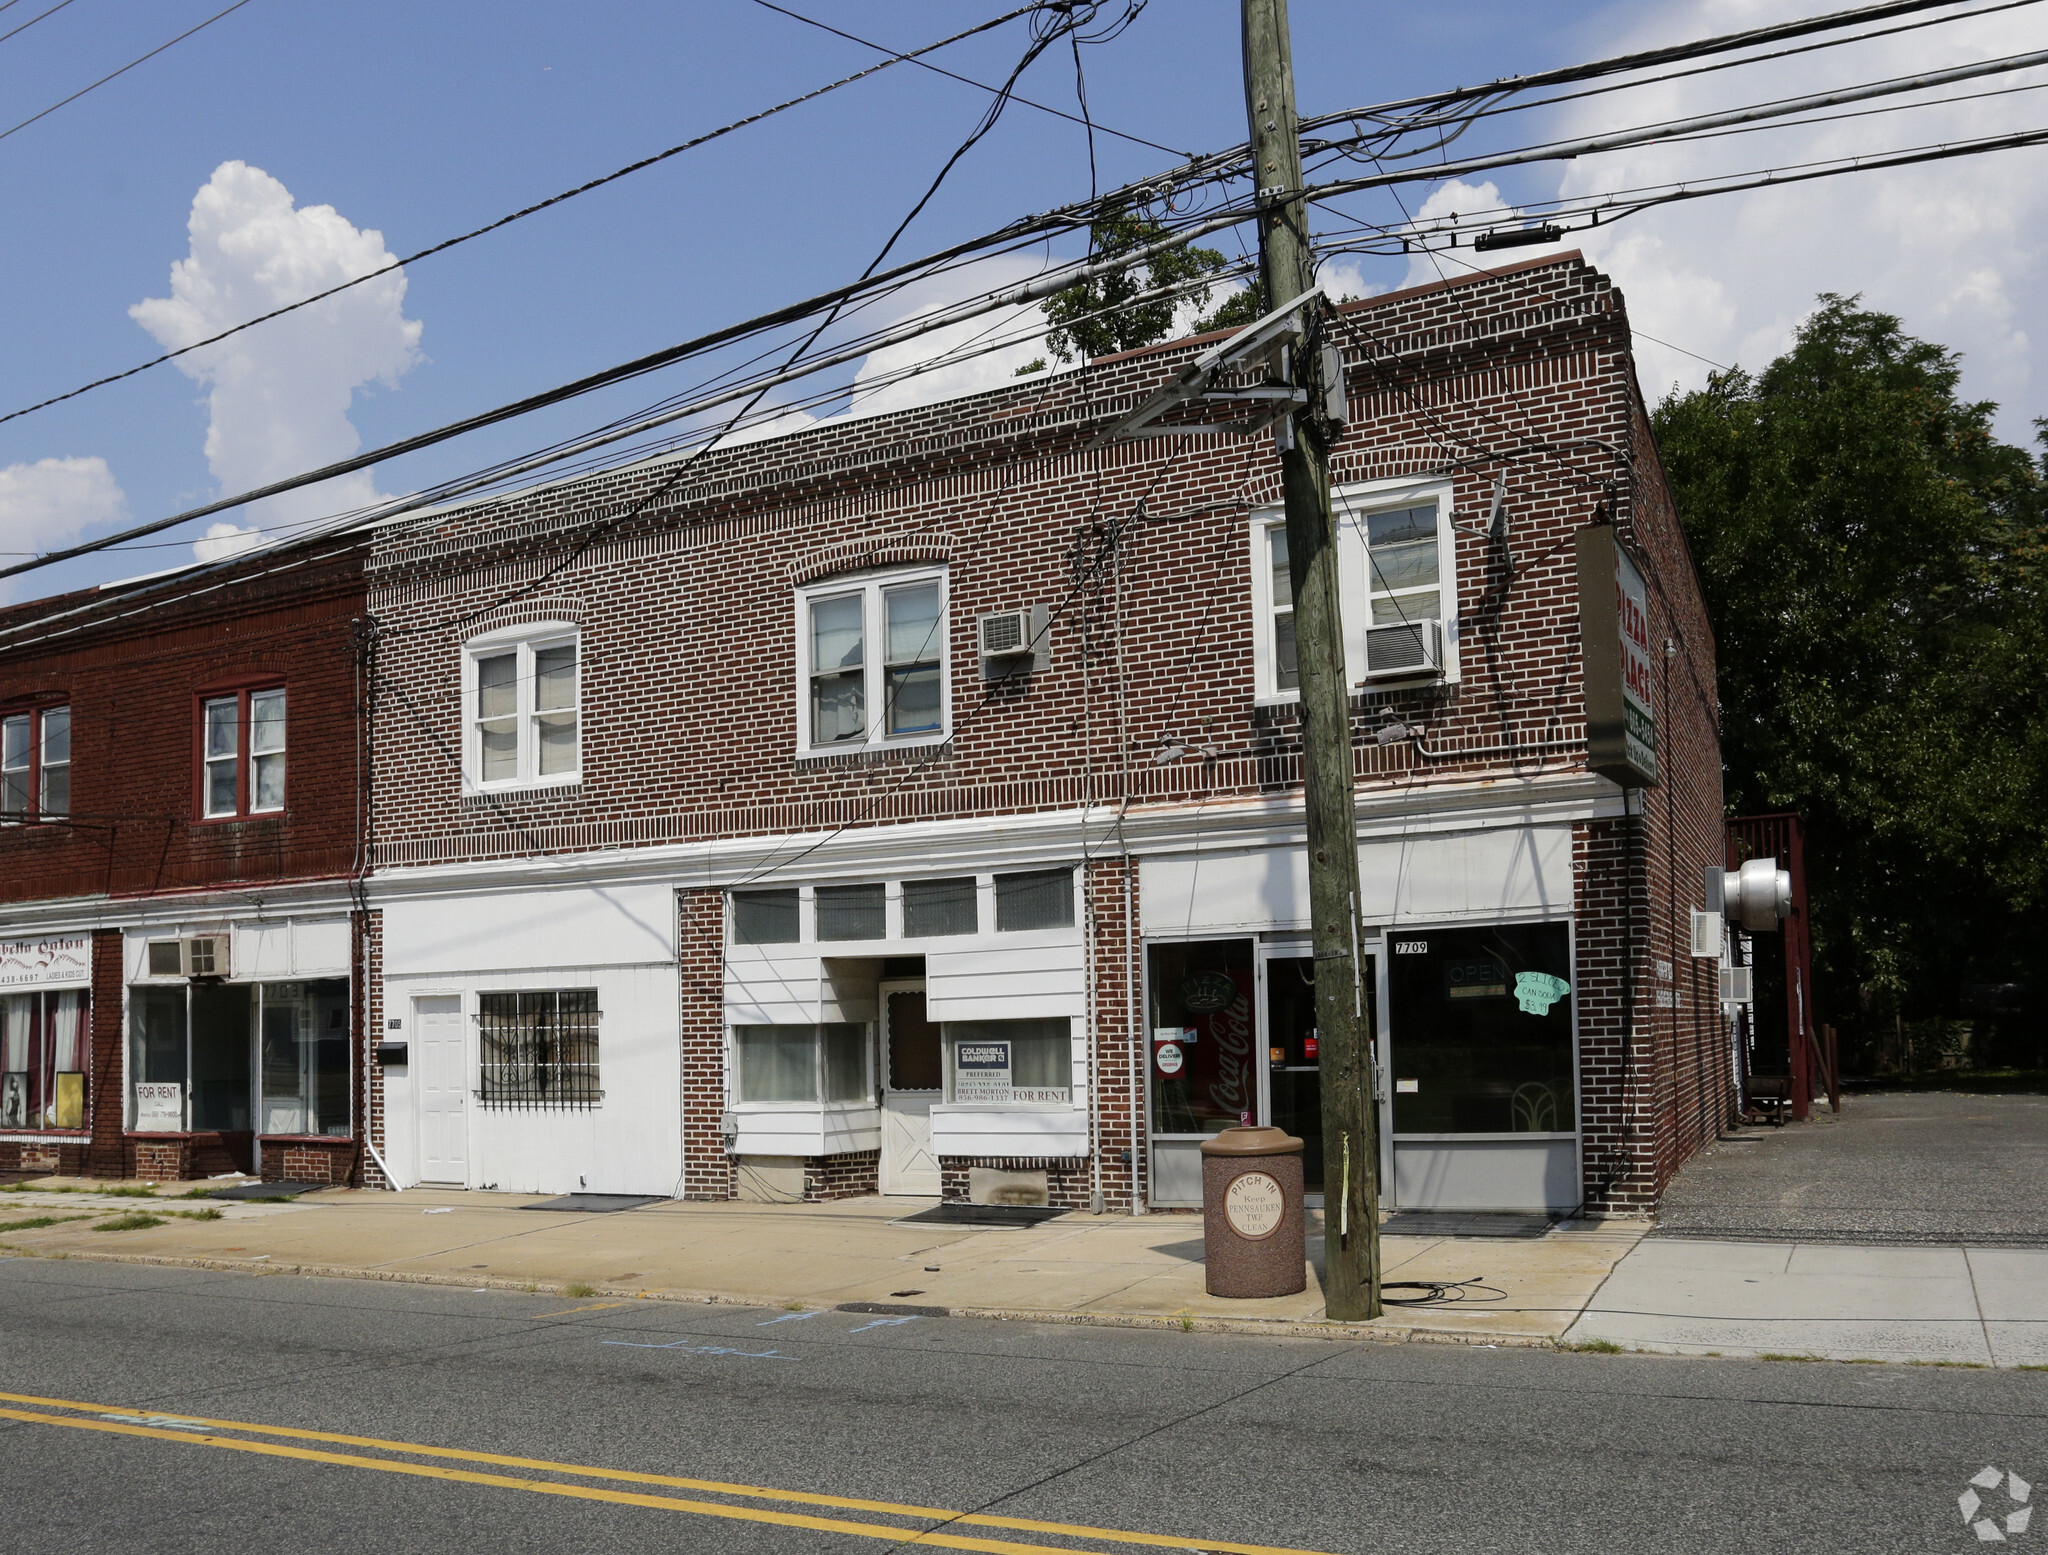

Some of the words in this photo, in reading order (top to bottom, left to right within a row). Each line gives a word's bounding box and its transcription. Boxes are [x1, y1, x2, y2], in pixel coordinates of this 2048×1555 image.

[1397, 942, 1426, 953] 7709
[1450, 964, 1506, 983] OPEN
[1518, 972, 1527, 983] 2
[1522, 986, 1537, 996] CAN
[961, 1047, 1005, 1055] COLDWELL
[962, 1054, 997, 1063] BANKER
[138, 1086, 156, 1099] FOR
[157, 1086, 177, 1099] RENT
[1013, 1090, 1037, 1101] FOR
[1038, 1090, 1067, 1101] RENT
[1231, 1176, 1262, 1196] PITCH
[1265, 1181, 1277, 1195] IN
[1244, 1195, 1266, 1203] Keep
[1229, 1202, 1281, 1213] PENNSAUKEN
[1242, 1223, 1268, 1231] CLEAN
